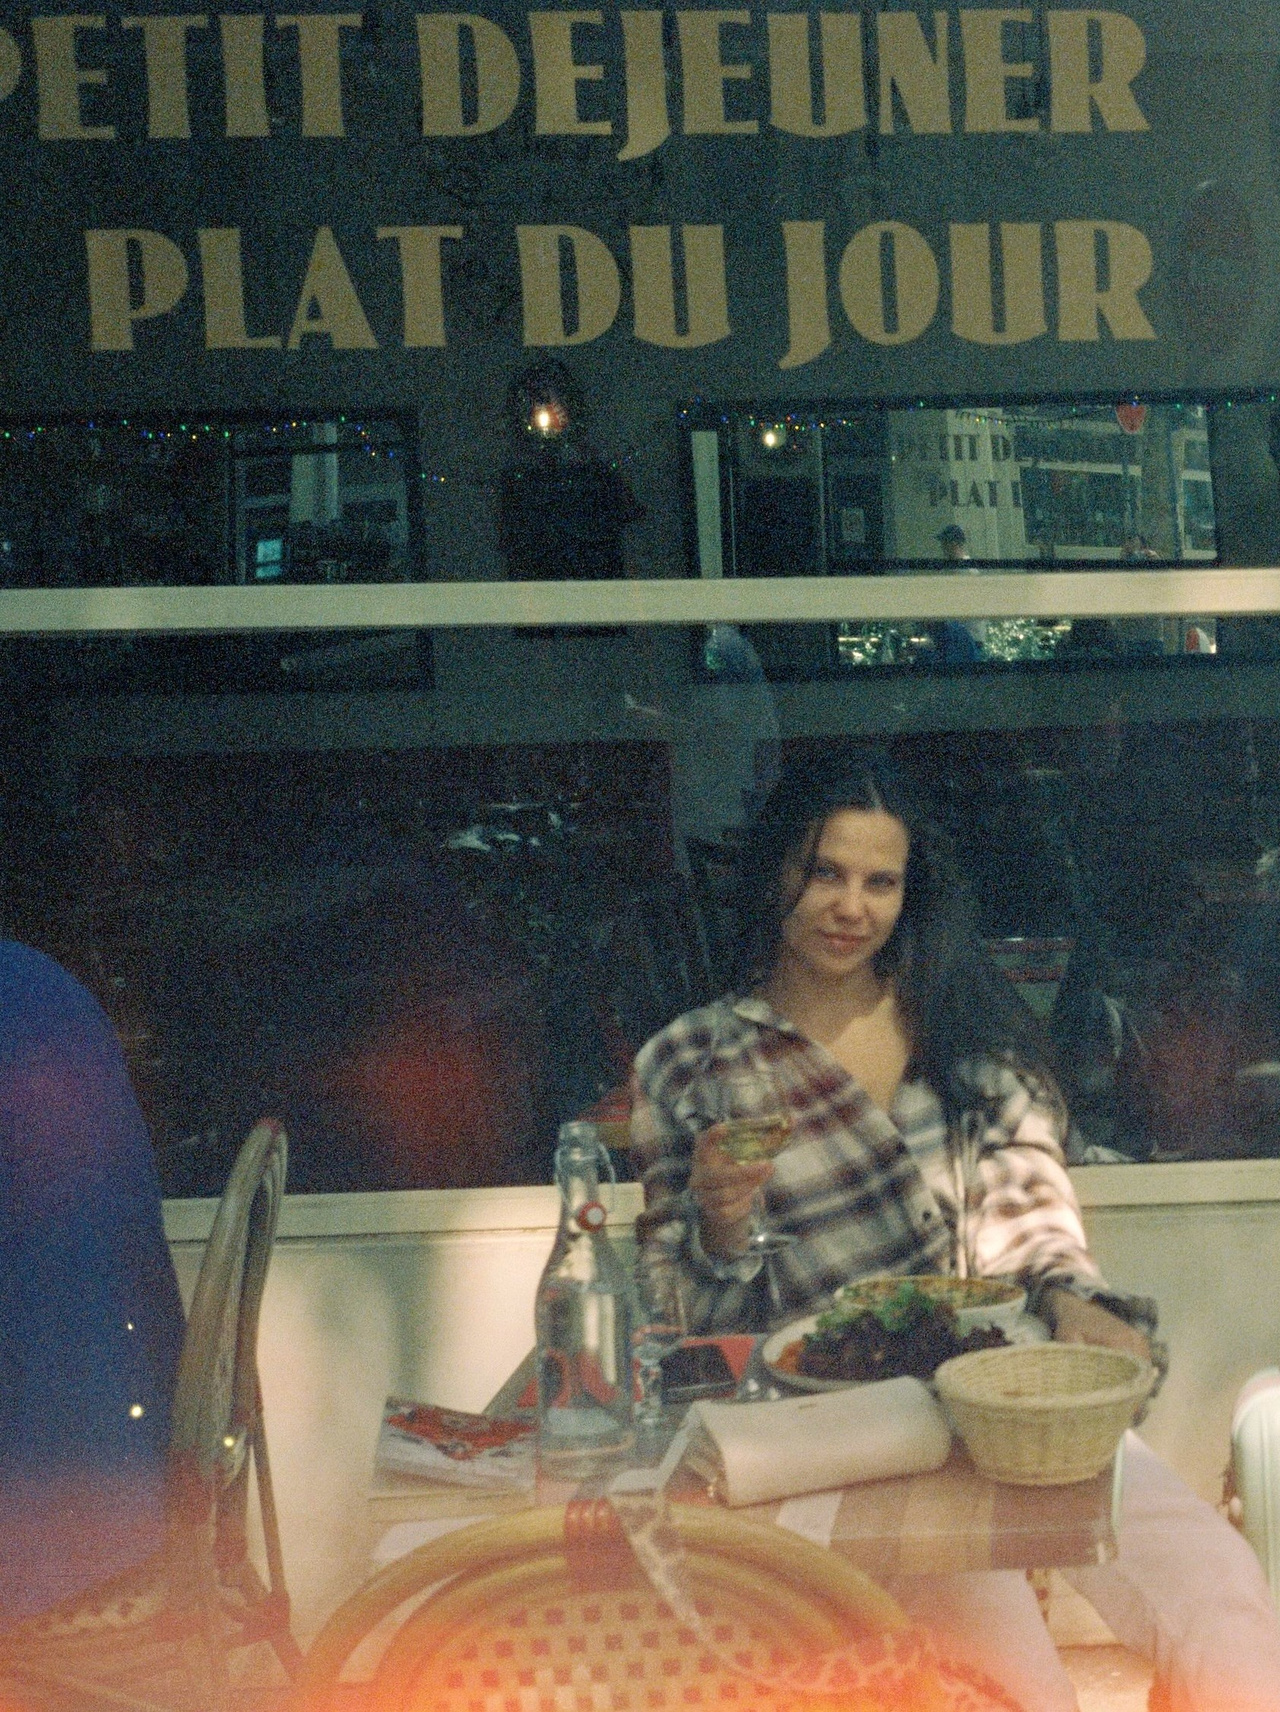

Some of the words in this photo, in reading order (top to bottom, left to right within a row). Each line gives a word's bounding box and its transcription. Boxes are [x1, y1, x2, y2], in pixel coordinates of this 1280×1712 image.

[0, 10, 363, 142] ETIT
[413, 6, 1152, 162] DEJEUNER
[84, 223, 464, 353] PLAT
[514, 222, 733, 351] DU
[778, 219, 1159, 370] JOUR
